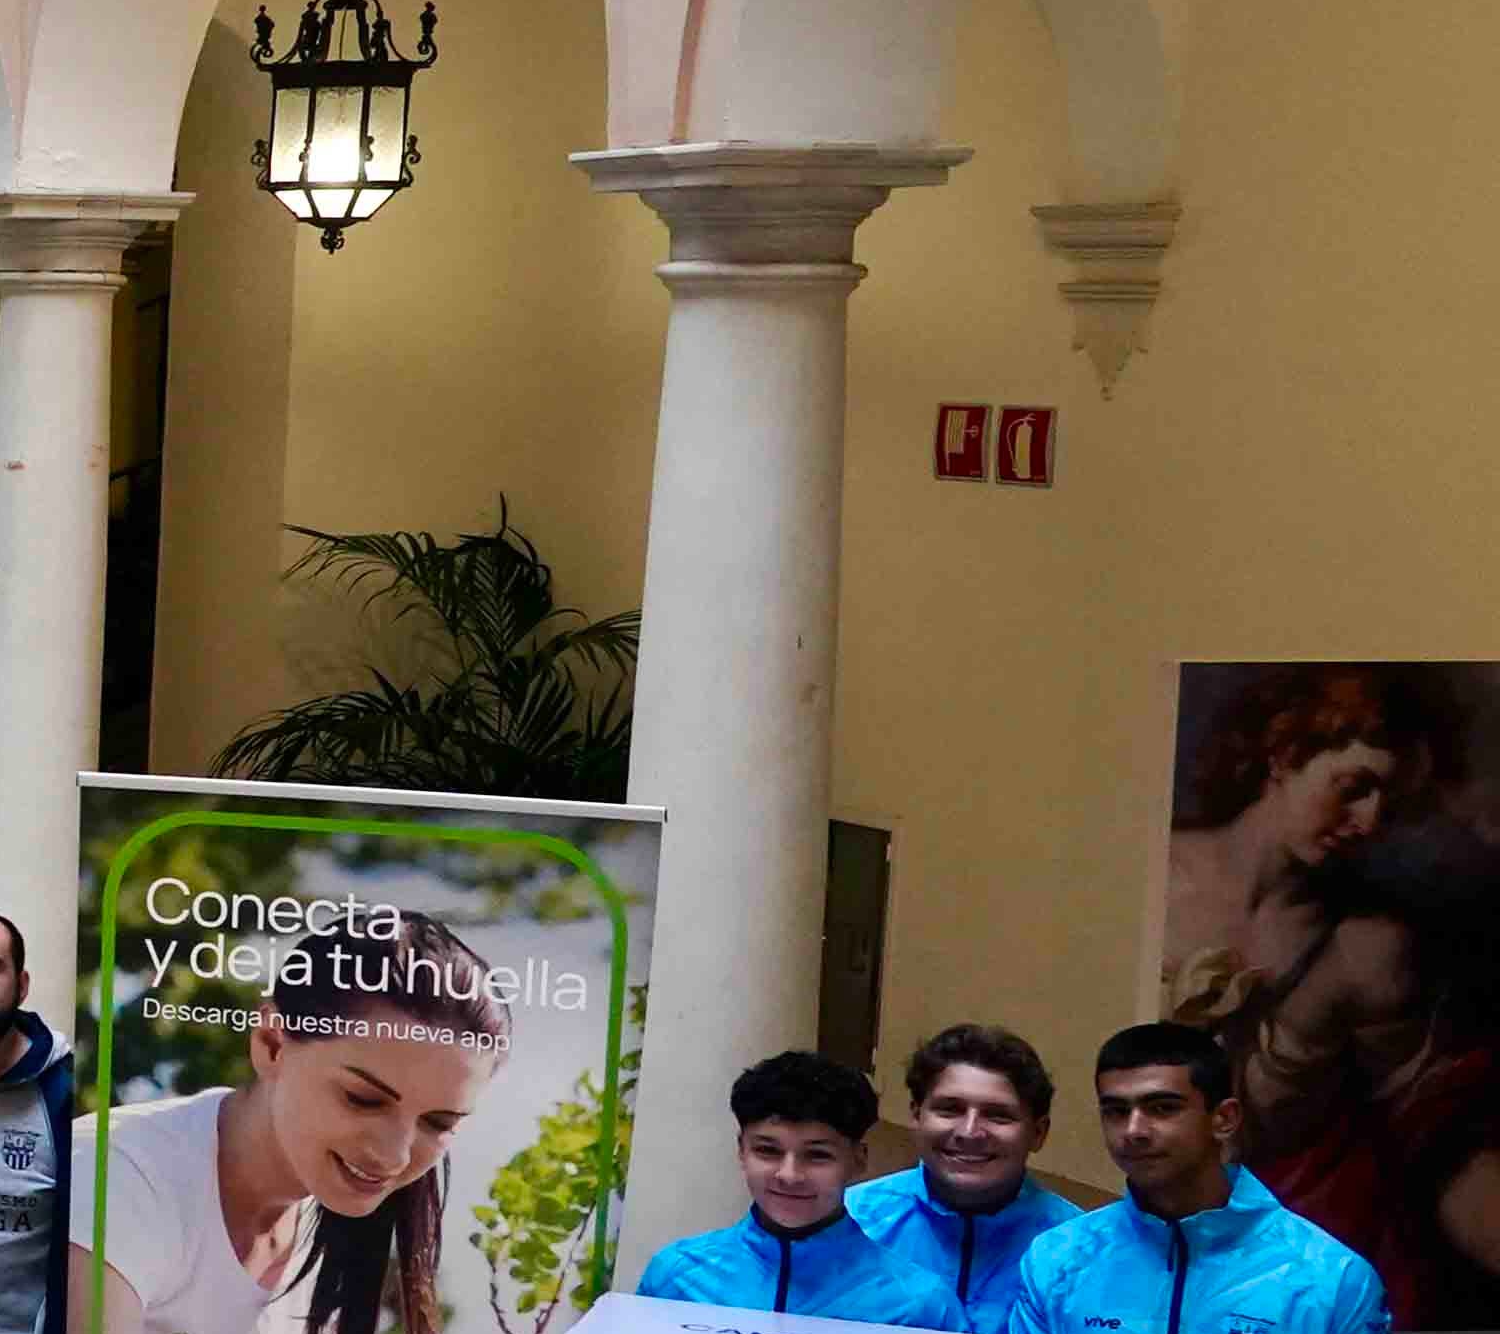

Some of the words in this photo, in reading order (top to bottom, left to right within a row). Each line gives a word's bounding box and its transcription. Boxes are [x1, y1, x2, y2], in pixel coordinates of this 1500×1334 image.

[145, 876, 404, 942] Conecta
[144, 939, 178, 988] y
[190, 932, 313, 997] deja
[326, 945, 390, 993] tu
[407, 947, 587, 1011] huella
[143, 997, 262, 1031] Descarga
[269, 1011, 369, 1037] nuestra
[376, 1021, 454, 1045] nueva
[460, 1029, 510, 1053] app
[1084, 1315, 1122, 1330] vive
